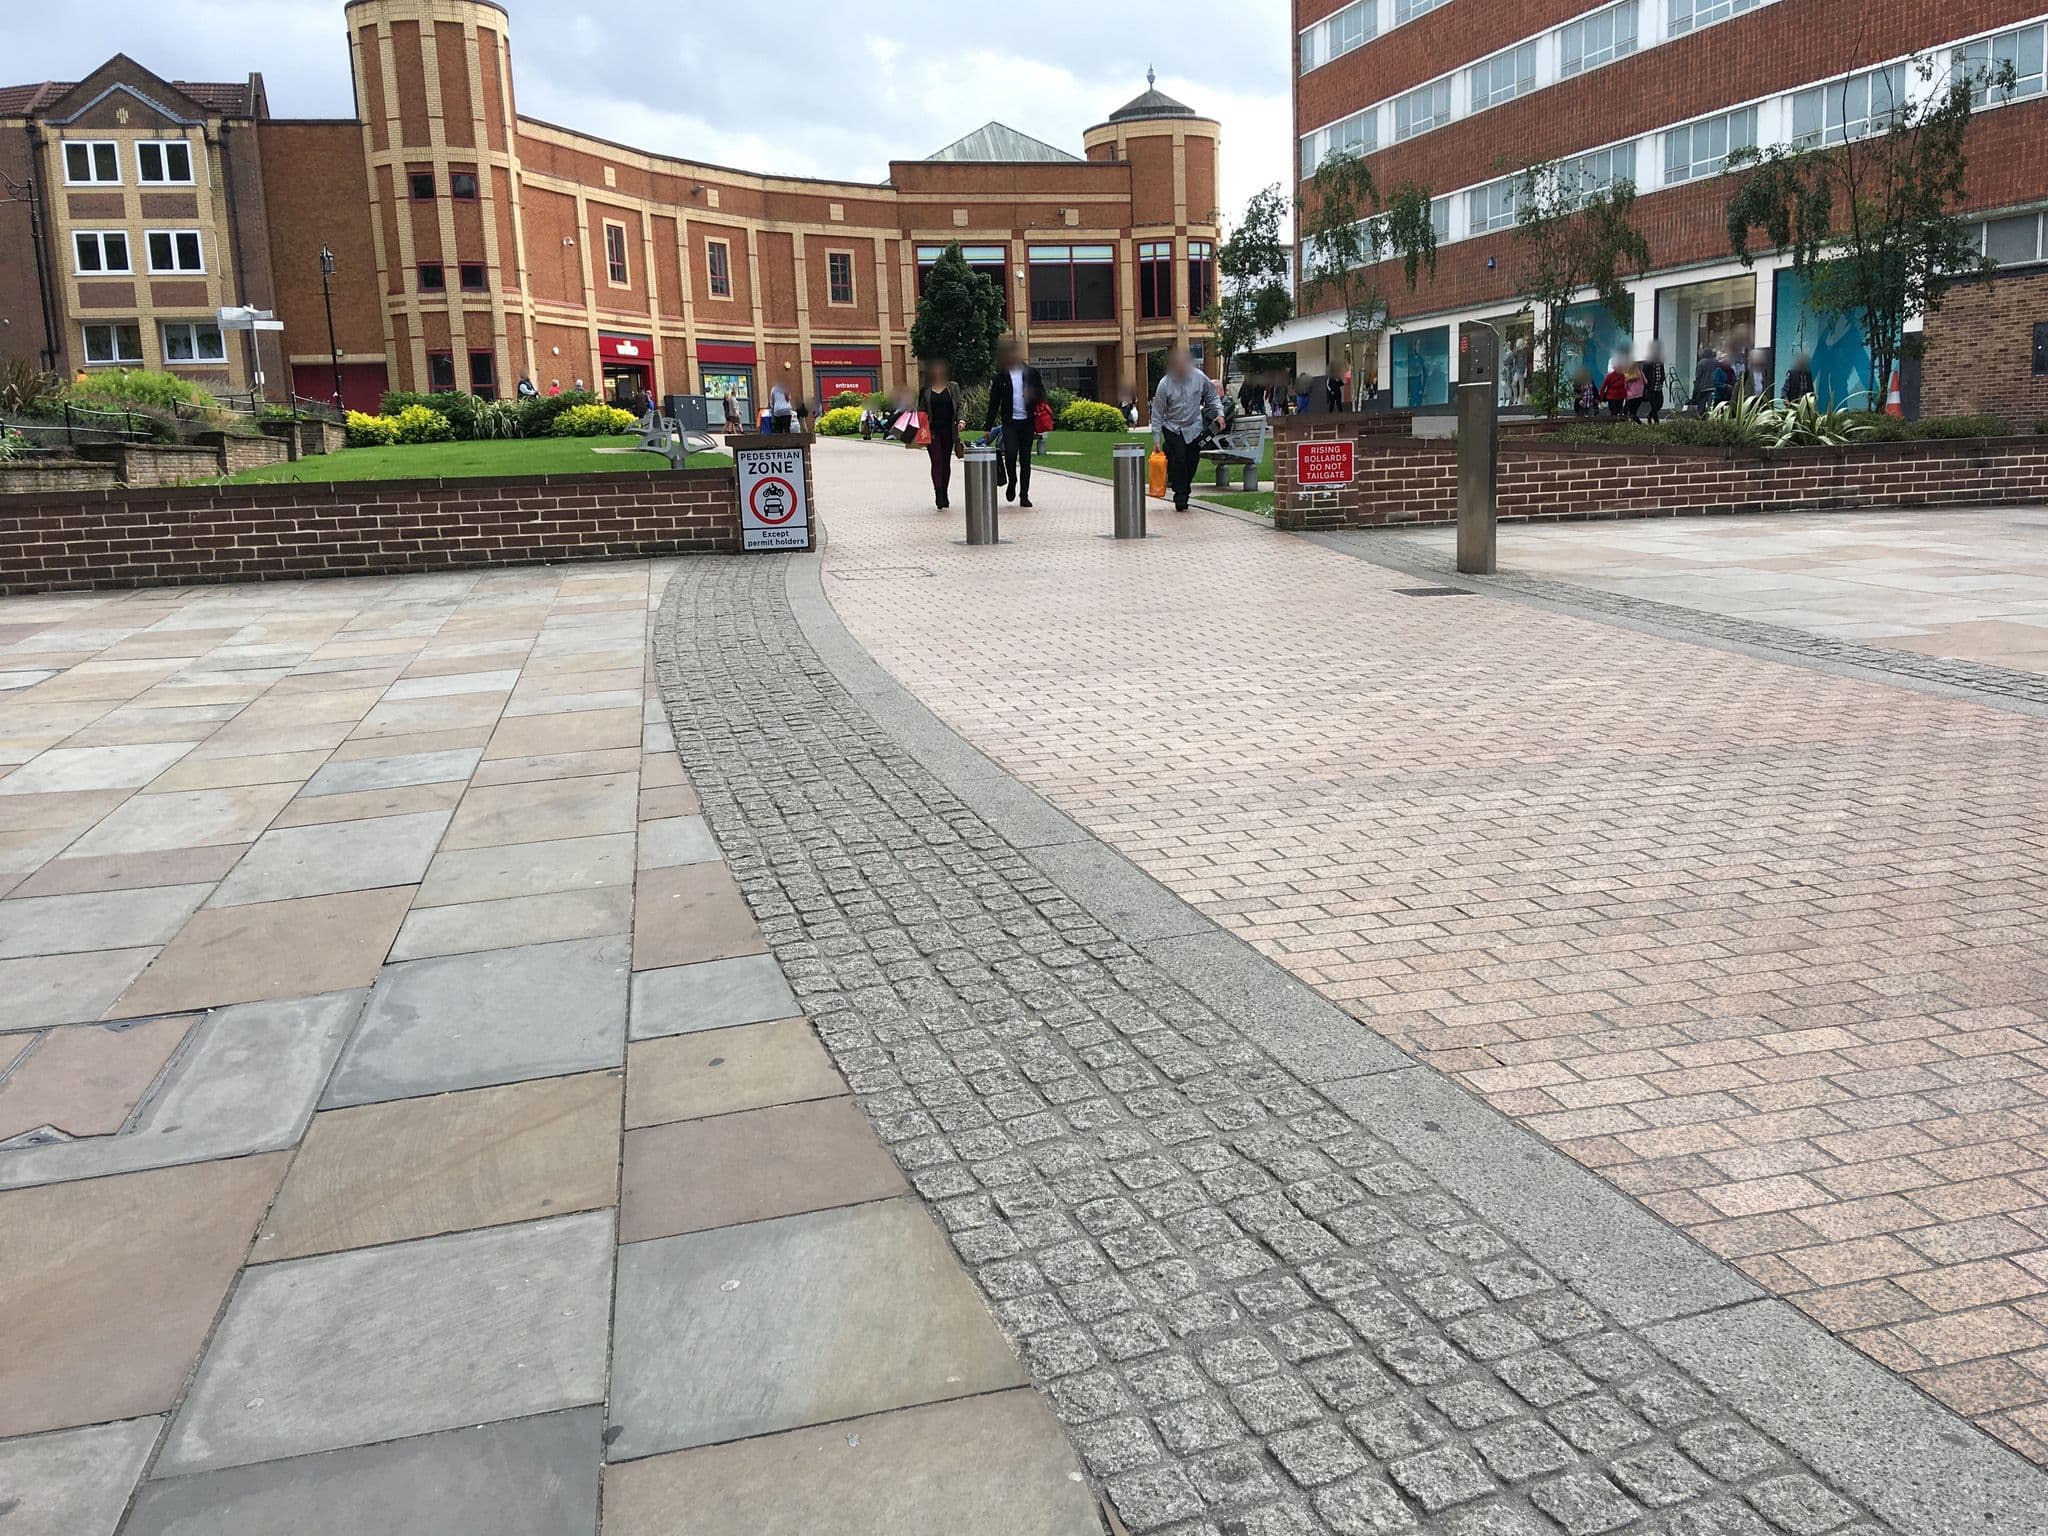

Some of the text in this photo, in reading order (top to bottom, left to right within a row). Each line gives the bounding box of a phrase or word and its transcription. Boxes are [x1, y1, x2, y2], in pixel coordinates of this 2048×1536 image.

[1311, 445, 1341, 454] RISING
[740, 451, 800, 461] PEDESTRIAN
[1304, 454, 1347, 463] BOLLARDS
[748, 461, 793, 475] ZONE
[1310, 462, 1342, 471] DO NOT
[1306, 471, 1345, 480] TAILGATE
[762, 530, 789, 538] Except
[747, 538, 805, 547] permit holders
